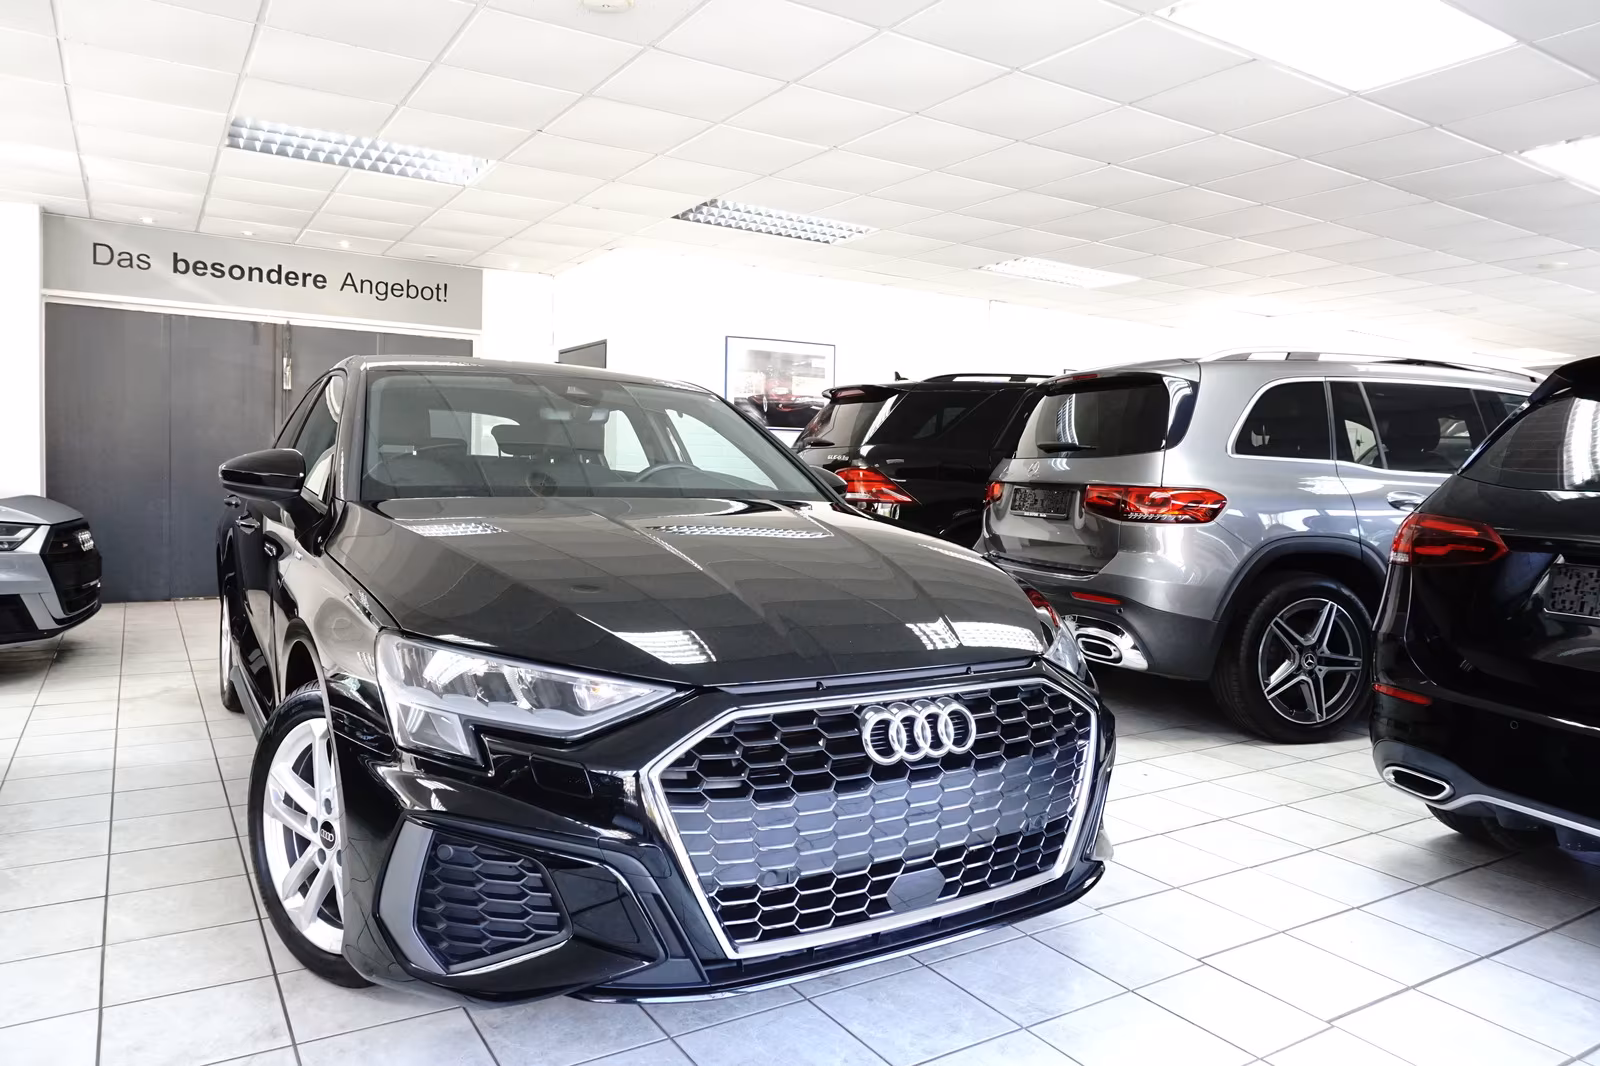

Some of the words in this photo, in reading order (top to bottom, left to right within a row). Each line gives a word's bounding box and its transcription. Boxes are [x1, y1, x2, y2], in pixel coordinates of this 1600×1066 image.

[92, 242, 152, 271] Das
[172, 251, 328, 290] besondere
[339, 272, 449, 303] Angebot!
